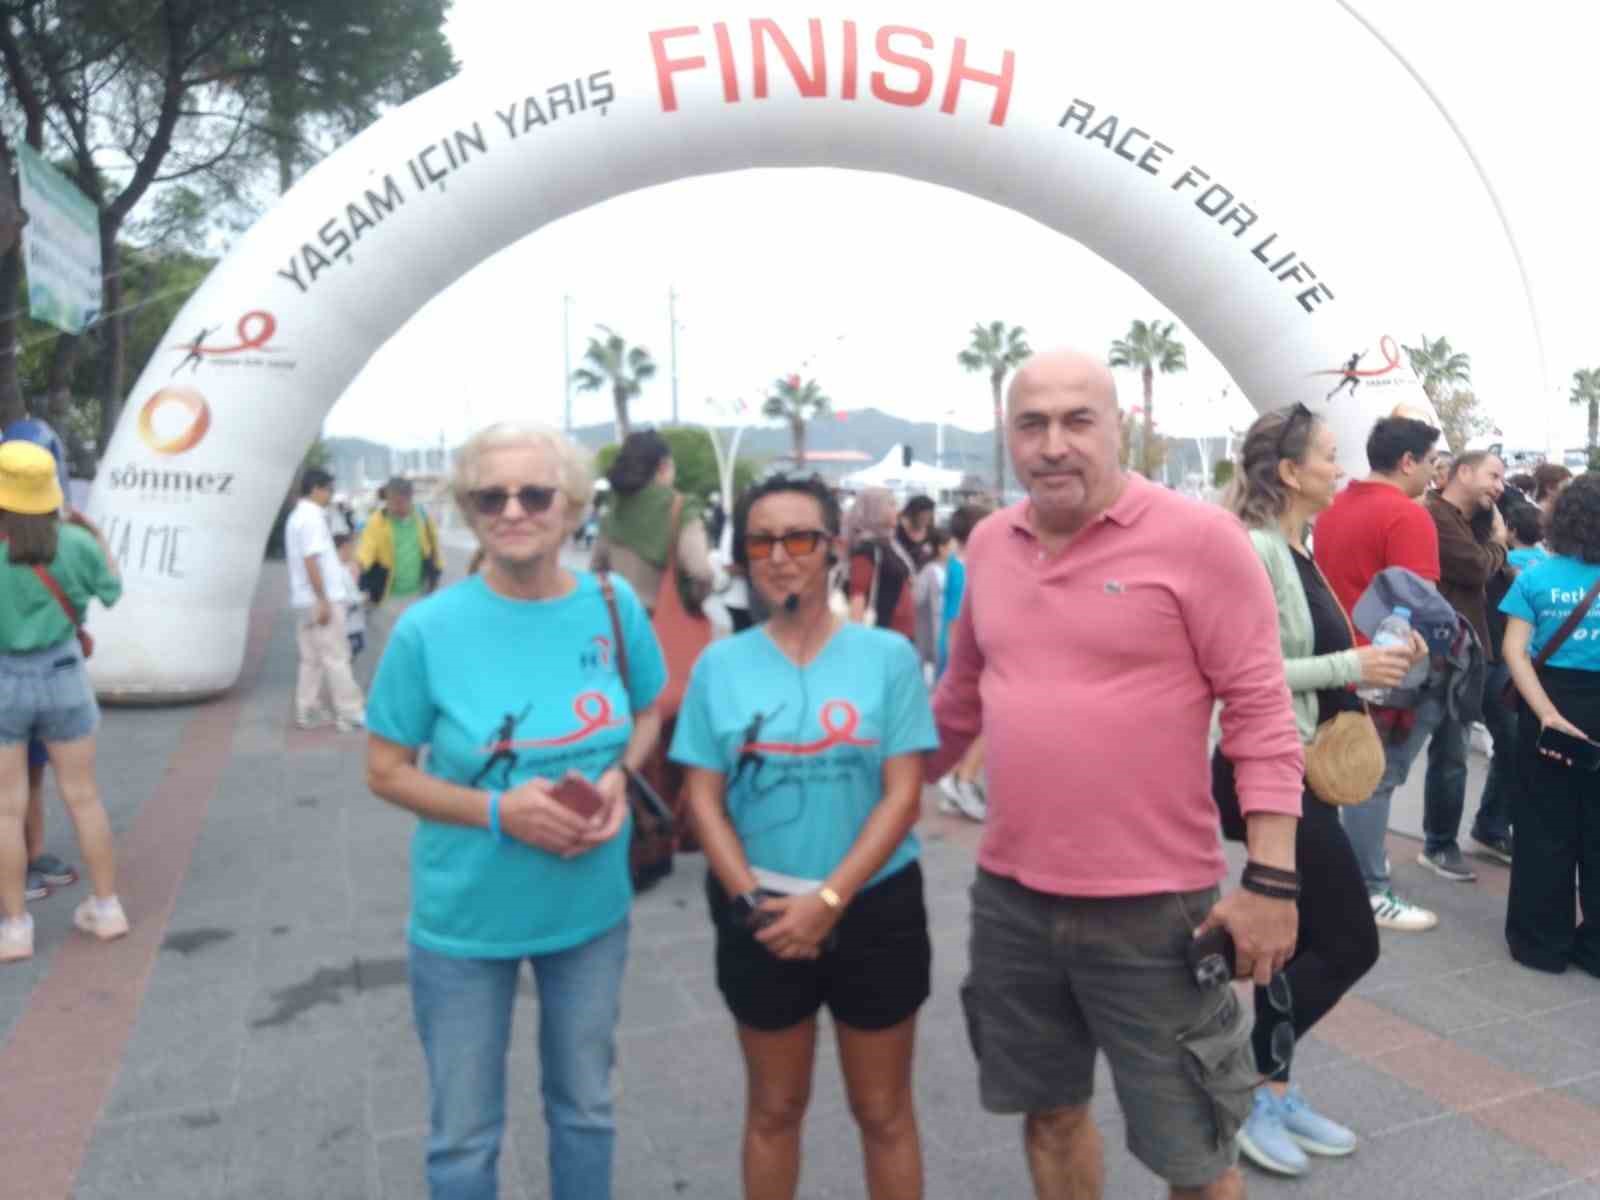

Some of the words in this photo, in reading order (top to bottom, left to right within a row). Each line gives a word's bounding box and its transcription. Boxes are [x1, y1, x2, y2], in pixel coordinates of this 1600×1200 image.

[647, 17, 1016, 128] FINISH
[277, 173, 405, 293] YAŞAM
[495, 69, 616, 139] YARIŞ
[1058, 98, 1175, 176] RACE
[1171, 164, 1259, 238] FOR
[1250, 232, 1335, 313] LIFE
